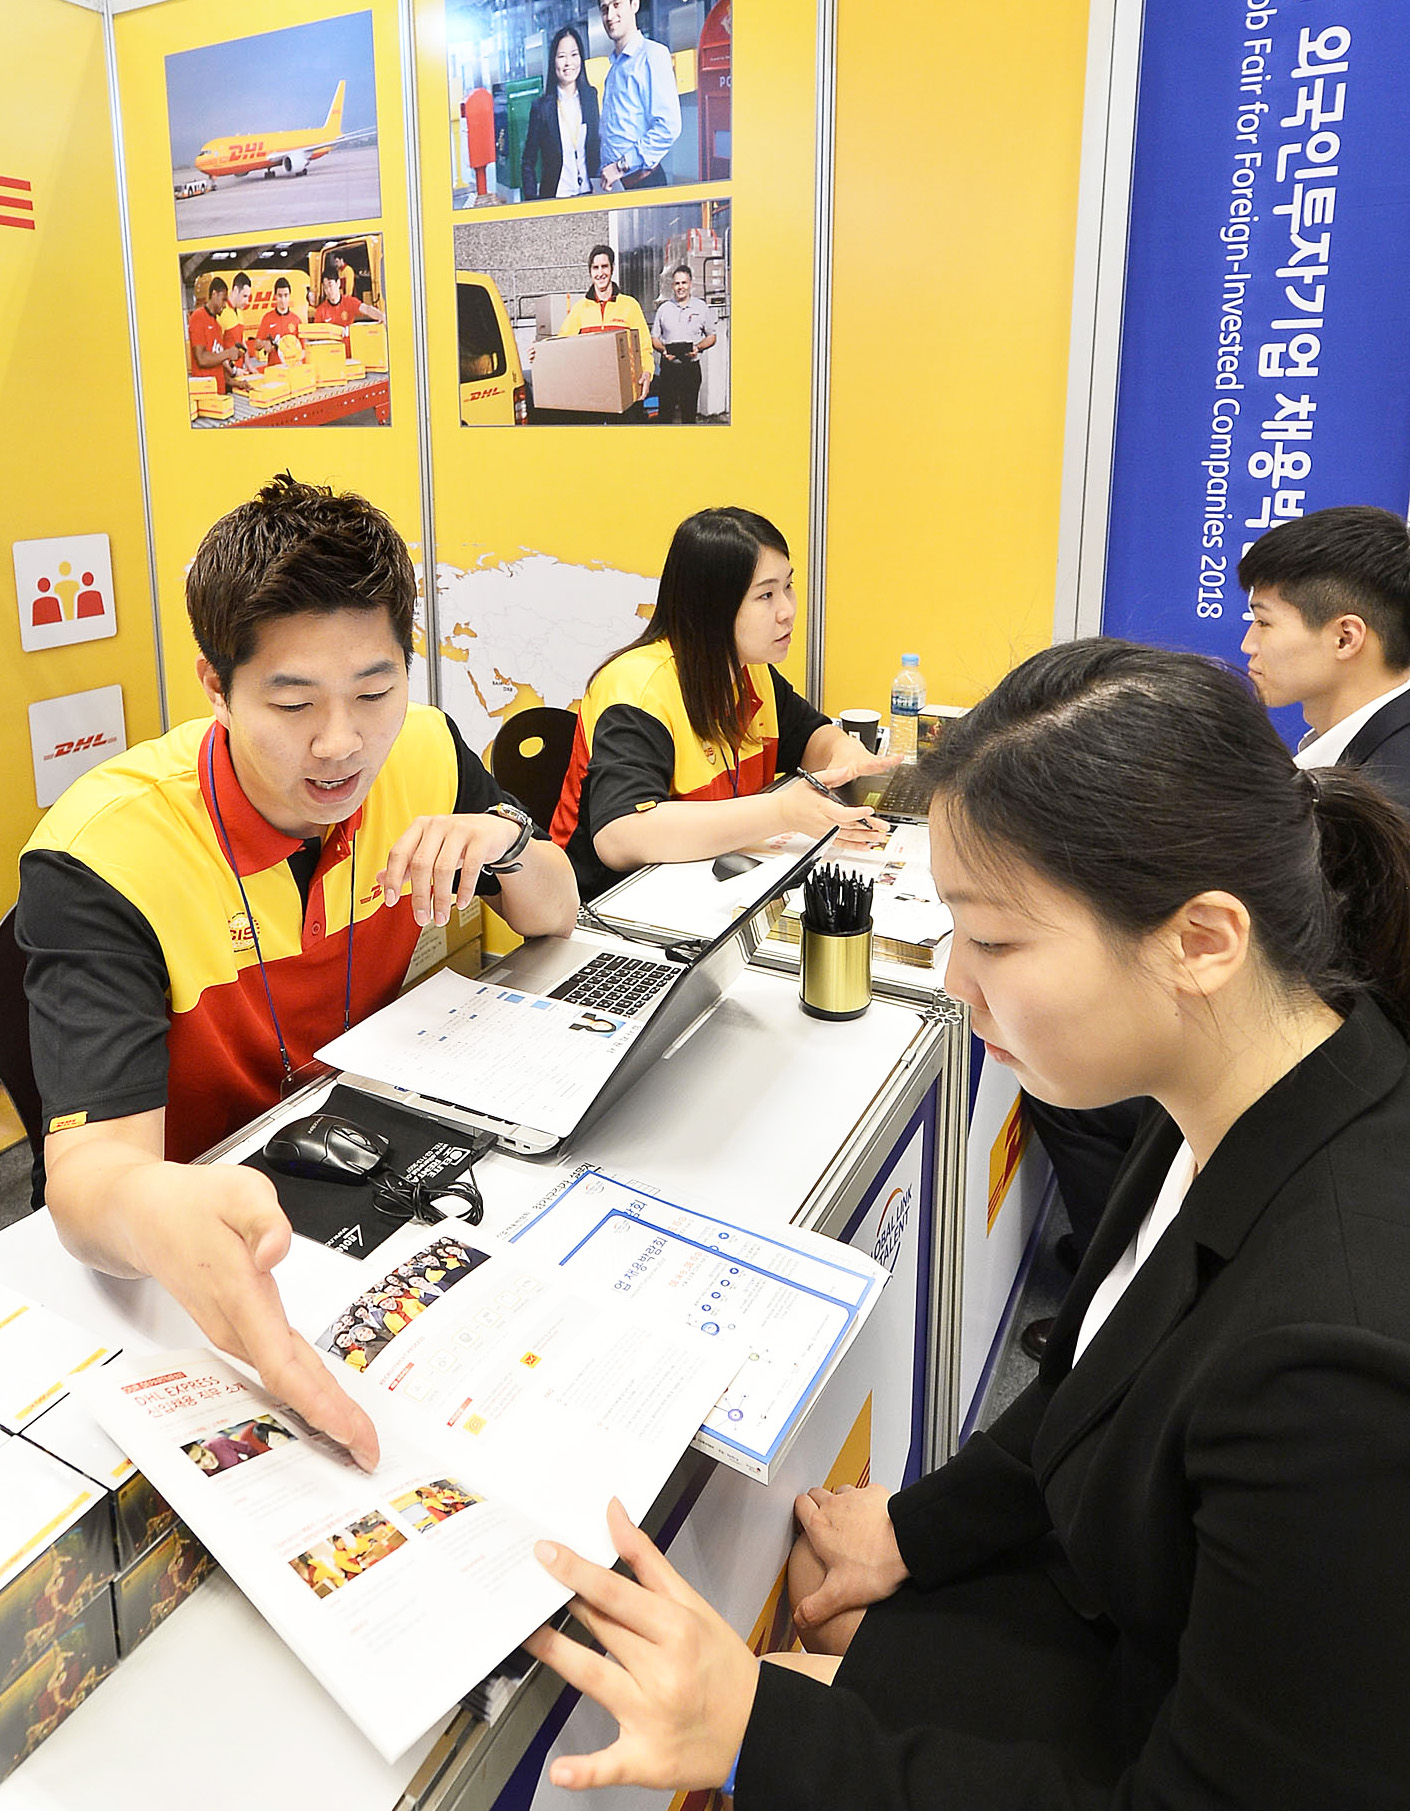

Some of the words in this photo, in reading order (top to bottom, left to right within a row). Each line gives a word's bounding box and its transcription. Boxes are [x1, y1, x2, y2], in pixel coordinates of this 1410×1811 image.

[1240, 38, 1272, 95] Fair
[1236, 101, 1270, 144] for
[228, 142, 268, 162] DHL
[1258, 25, 1352, 378] 외국인투자기업
[1215, 152, 1262, 390] Foreign-Invested
[469, 387, 500, 402] DHL
[1201, 398, 1241, 548] Companies
[1242, 392, 1318, 575] 채용박
[1196, 555, 1228, 619] 2018
[54, 732, 107, 758] DHL
[896, 1182, 913, 1221] LINK
[624, 1236, 668, 1281] 채용박람회
[878, 1205, 911, 1267] TALENT
[134, 1391, 166, 1407] DHL
[164, 1375, 221, 1397] EXPRESS
